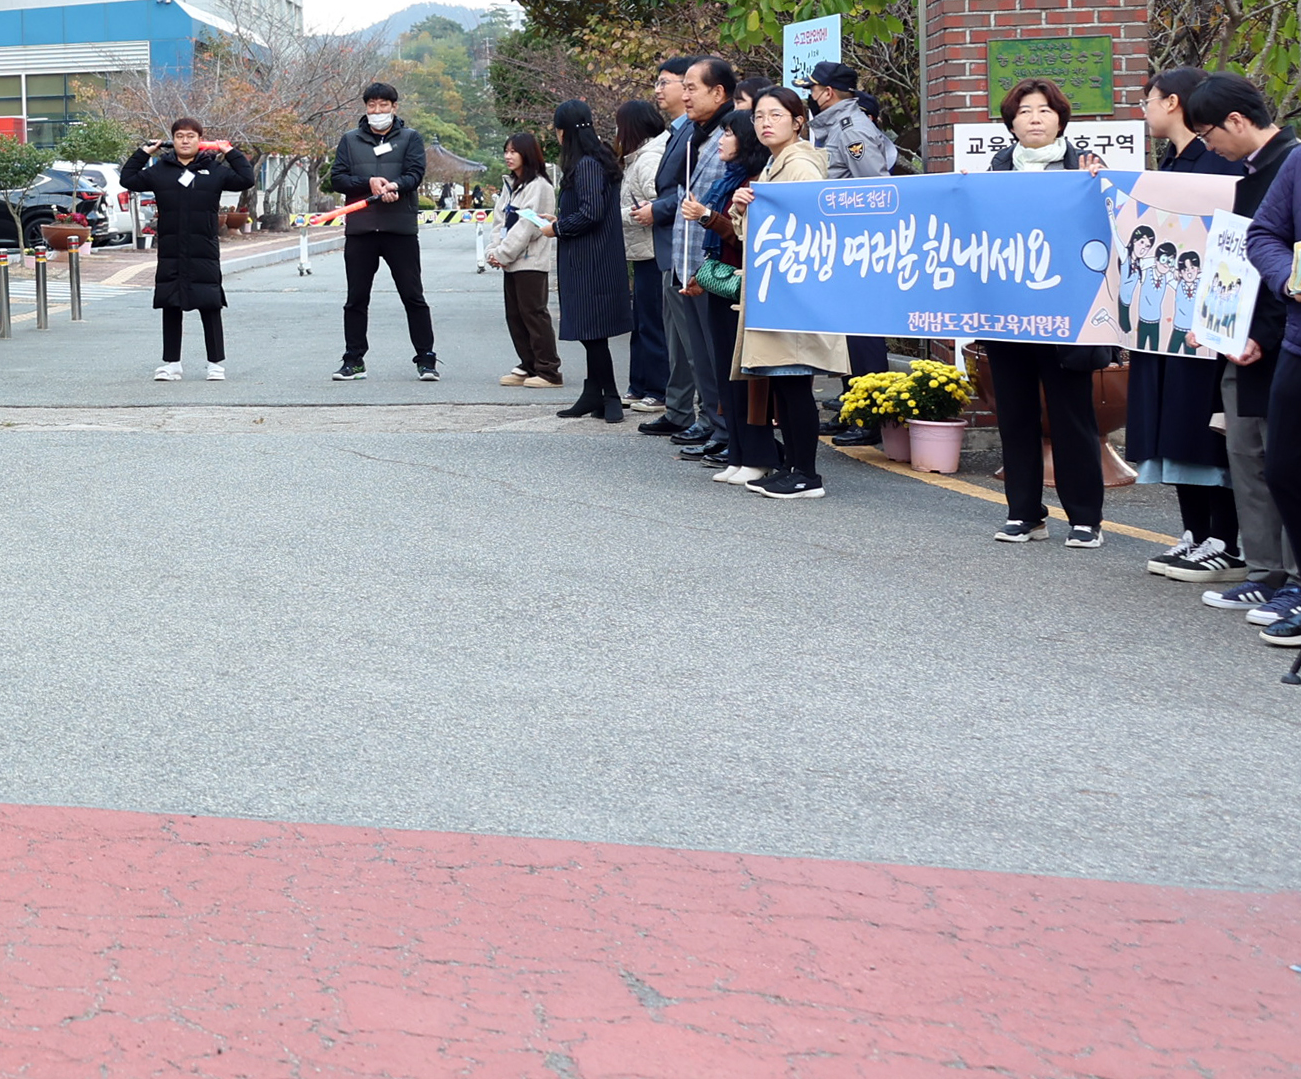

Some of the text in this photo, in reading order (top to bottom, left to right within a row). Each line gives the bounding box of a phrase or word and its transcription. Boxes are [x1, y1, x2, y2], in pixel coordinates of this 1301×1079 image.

[825, 191, 836, 209] 막
[866, 189, 892, 209] 정답!
[753, 213, 1062, 303] 수험생 여러분 힘내세요
